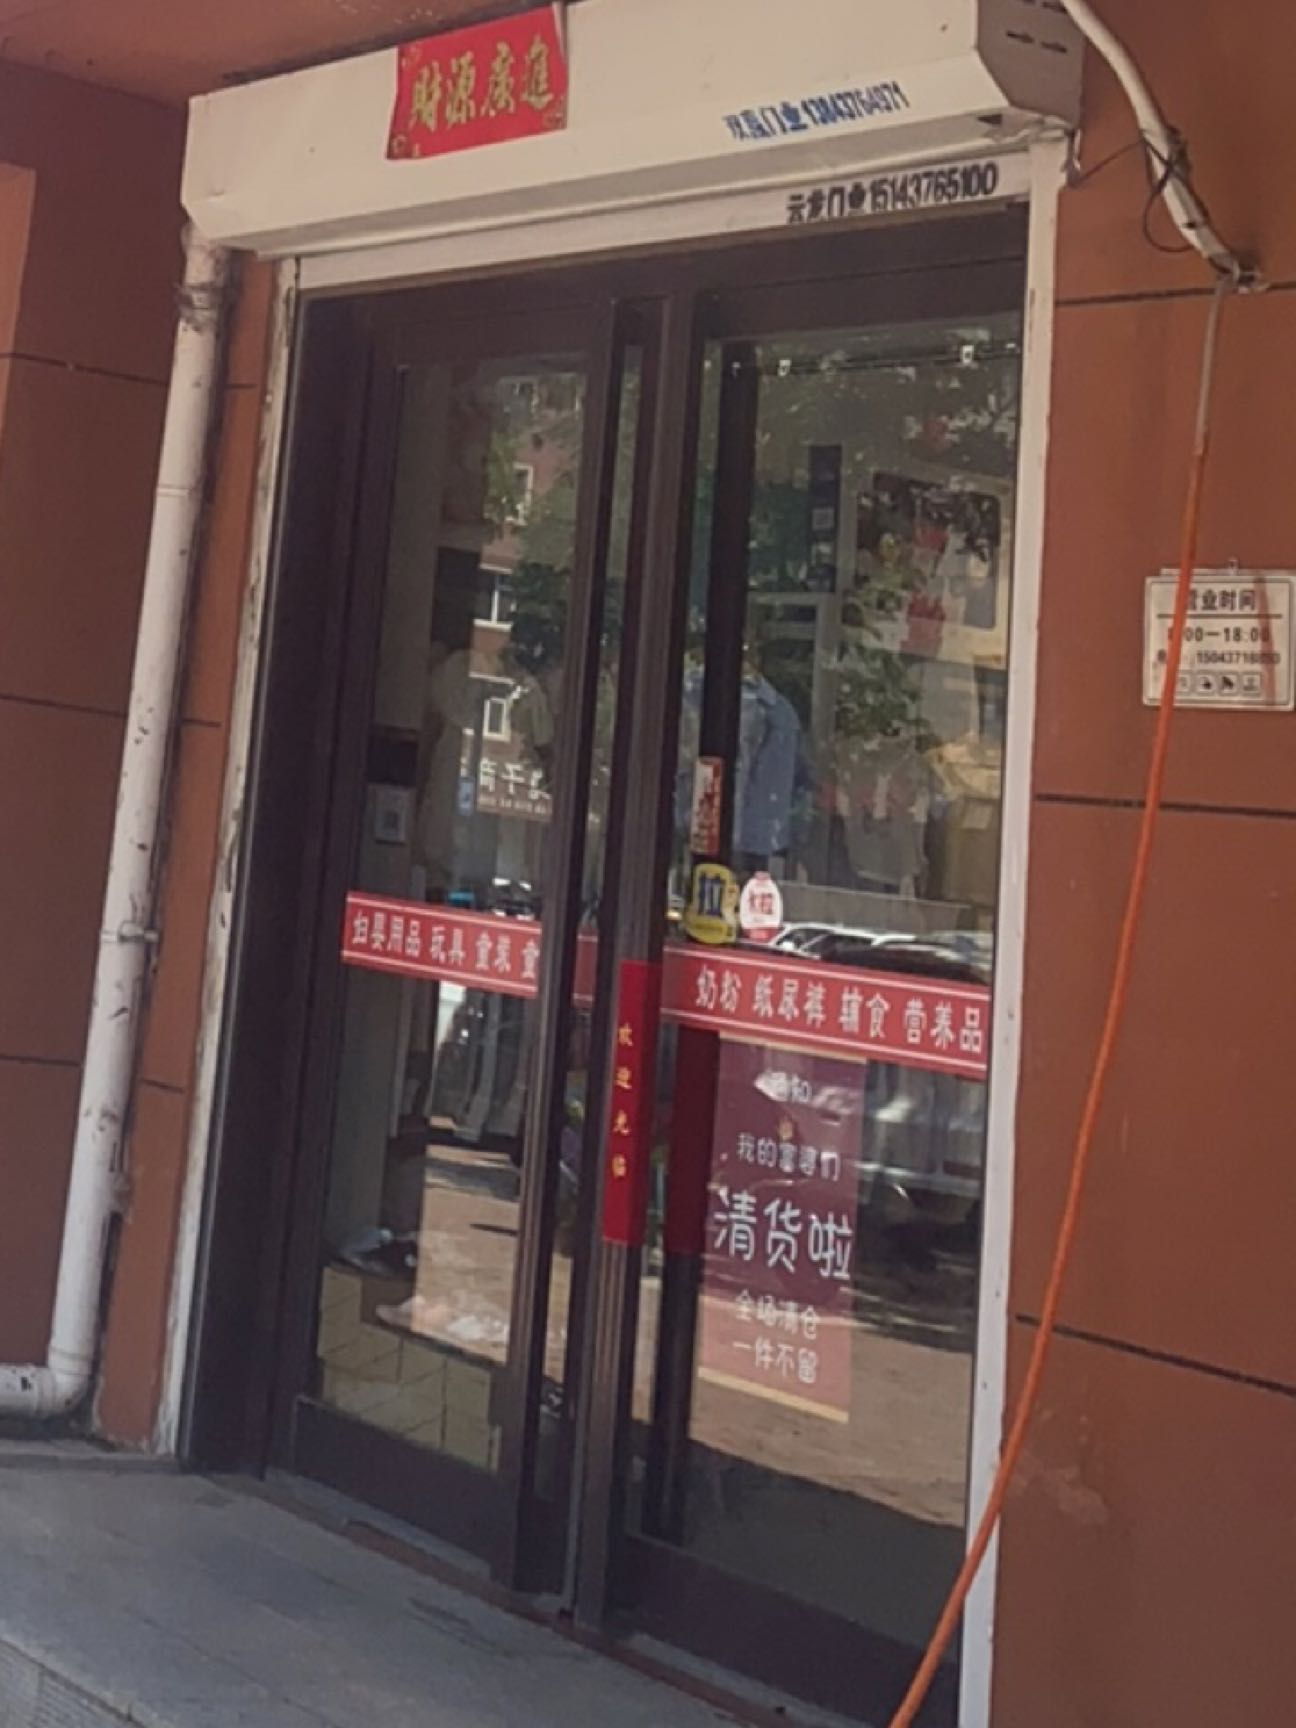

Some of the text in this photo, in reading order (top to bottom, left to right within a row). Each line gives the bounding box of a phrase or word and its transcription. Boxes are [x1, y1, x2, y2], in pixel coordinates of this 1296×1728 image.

[430, 925, 466, 965] 玩具
[695, 963, 982, 1054] 奶粉 纸尿裤 辅食 营养品
[713, 1185, 853, 1280] 清货啦
[735, 1288, 820, 1340] 全场清仓
[732, 1336, 817, 1384] 一件不留
